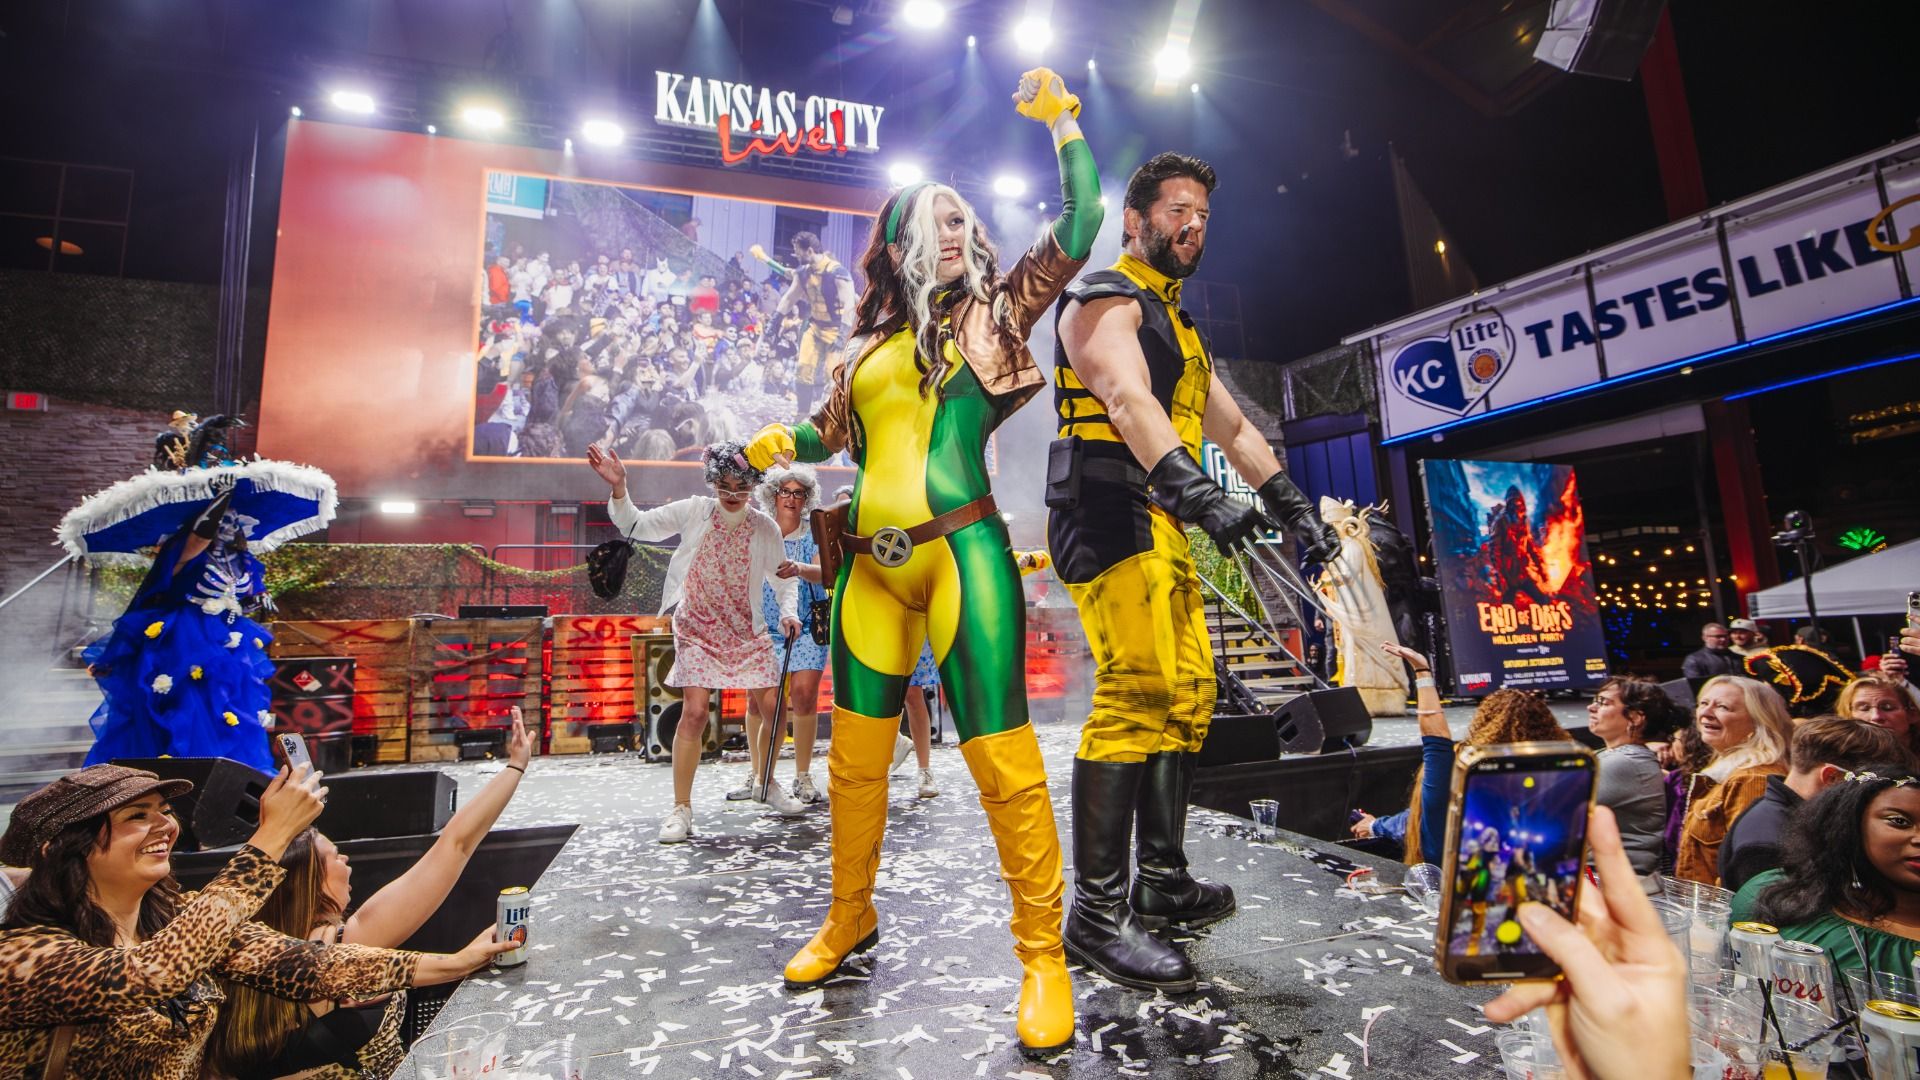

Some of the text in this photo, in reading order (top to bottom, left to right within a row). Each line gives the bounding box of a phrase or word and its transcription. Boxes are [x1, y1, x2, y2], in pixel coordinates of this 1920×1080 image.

[655, 70, 885, 150] KANSAS CITY
[718, 109, 848, 163] Live!
[1524, 267, 1730, 359] TASTES
[1738, 217, 1897, 298] LIKE
[1455, 321, 1499, 351] Lite
[1398, 359, 1445, 393] KC
[1476, 601, 1573, 634] END OF DAYS
[1492, 632, 1565, 645] HALLOWEEN PARTY
